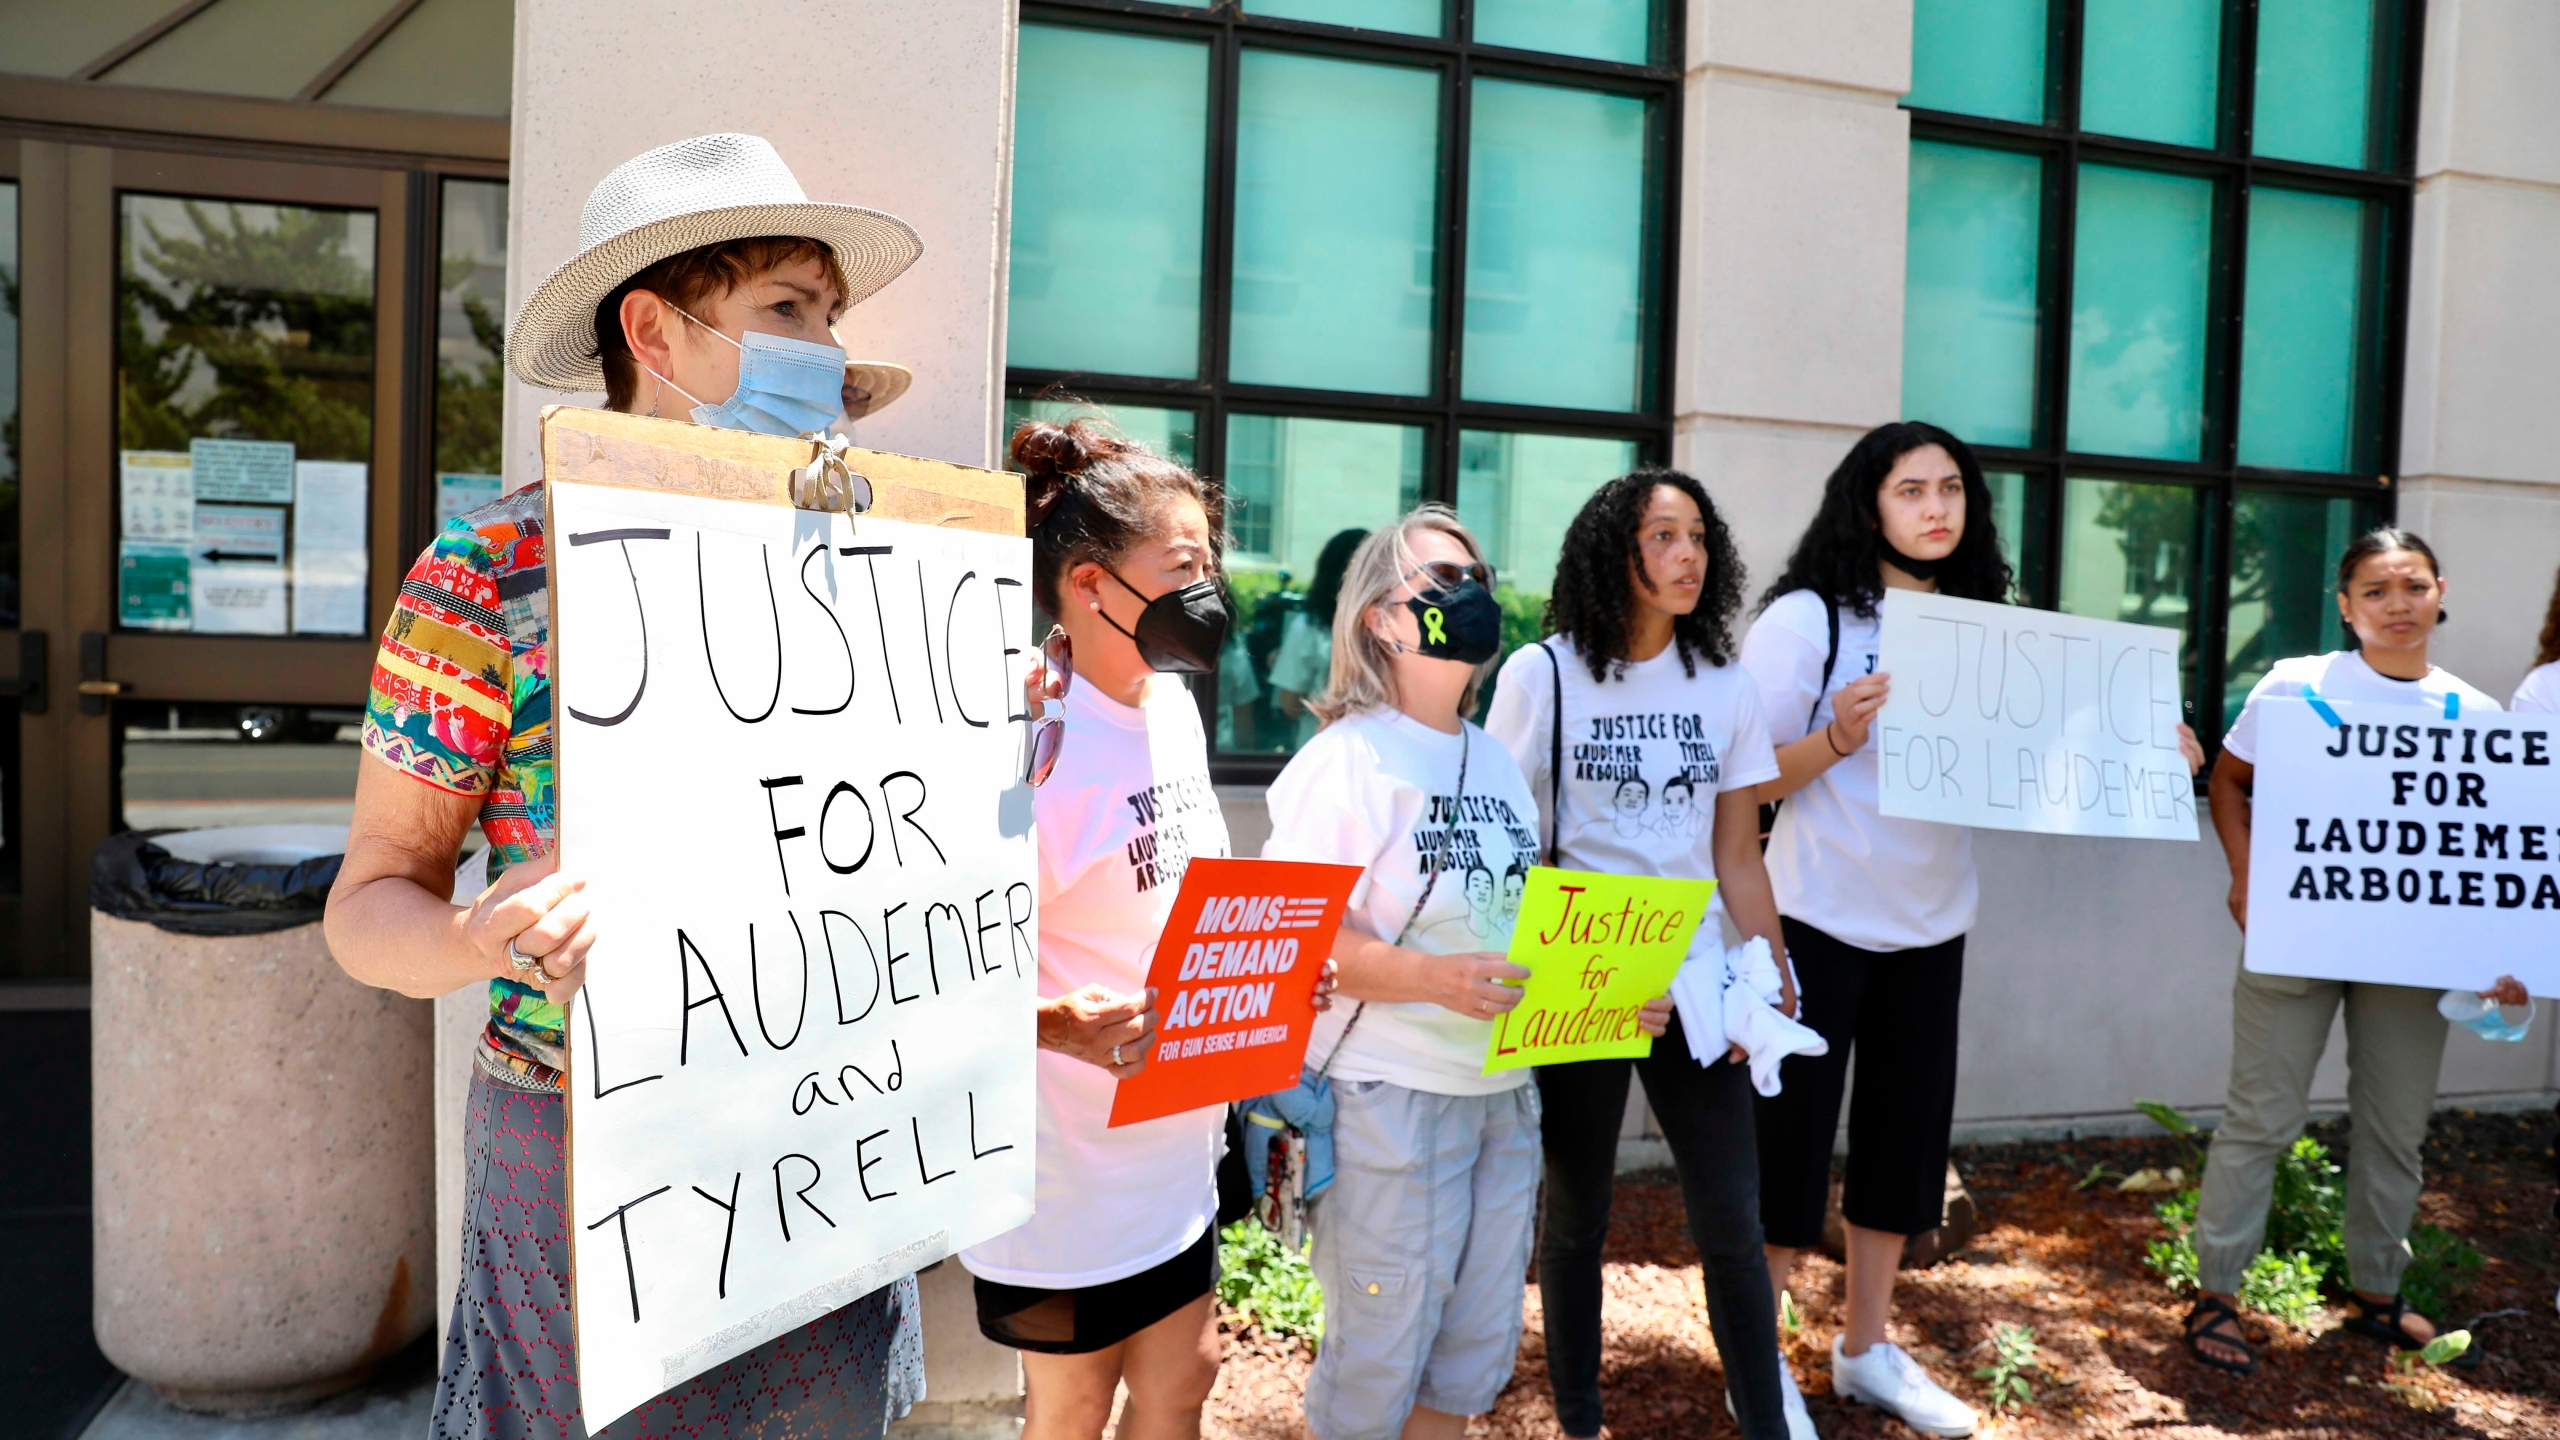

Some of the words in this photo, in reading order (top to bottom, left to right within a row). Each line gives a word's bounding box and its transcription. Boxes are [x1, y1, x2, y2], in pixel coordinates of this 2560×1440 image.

[568, 528, 1032, 728] JUSTICE
[1917, 614, 2177, 751] JUSTICE
[1591, 713, 1667, 741] JUSTICE
[1672, 713, 1705, 740] FOR
[2326, 724, 2550, 765] JUSTICE
[1573, 744, 1643, 764] LAUDEMER
[1679, 742, 1717, 763] TYRELL
[1883, 726, 1963, 797] FOR
[1986, 739, 2197, 823] LAUDEMER
[1429, 794, 1493, 824] JUTICE
[2392, 771, 2487, 808] FOR
[759, 770, 946, 898] FOR
[2295, 818, 2560, 863] LAUDEME
[2289, 866, 2560, 910] ARBOLEDA
[1194, 895, 1285, 934] MOMS
[1540, 885, 1684, 946] Justice
[1178, 937, 1299, 982] DEMAND
[1579, 954, 1618, 990] for
[582, 882, 1034, 1099] LAUDEMER
[1164, 982, 1275, 1030] ACTION
[1157, 1040, 1181, 1062] FOR
[1181, 1036, 1204, 1059] GUN
[1203, 1031, 1237, 1055] SENSE
[1235, 1029, 1248, 1050] IN
[1247, 1024, 1288, 1048] AMERICA
[792, 1039, 902, 1115] and
[587, 1091, 1013, 1323] TYRELL
